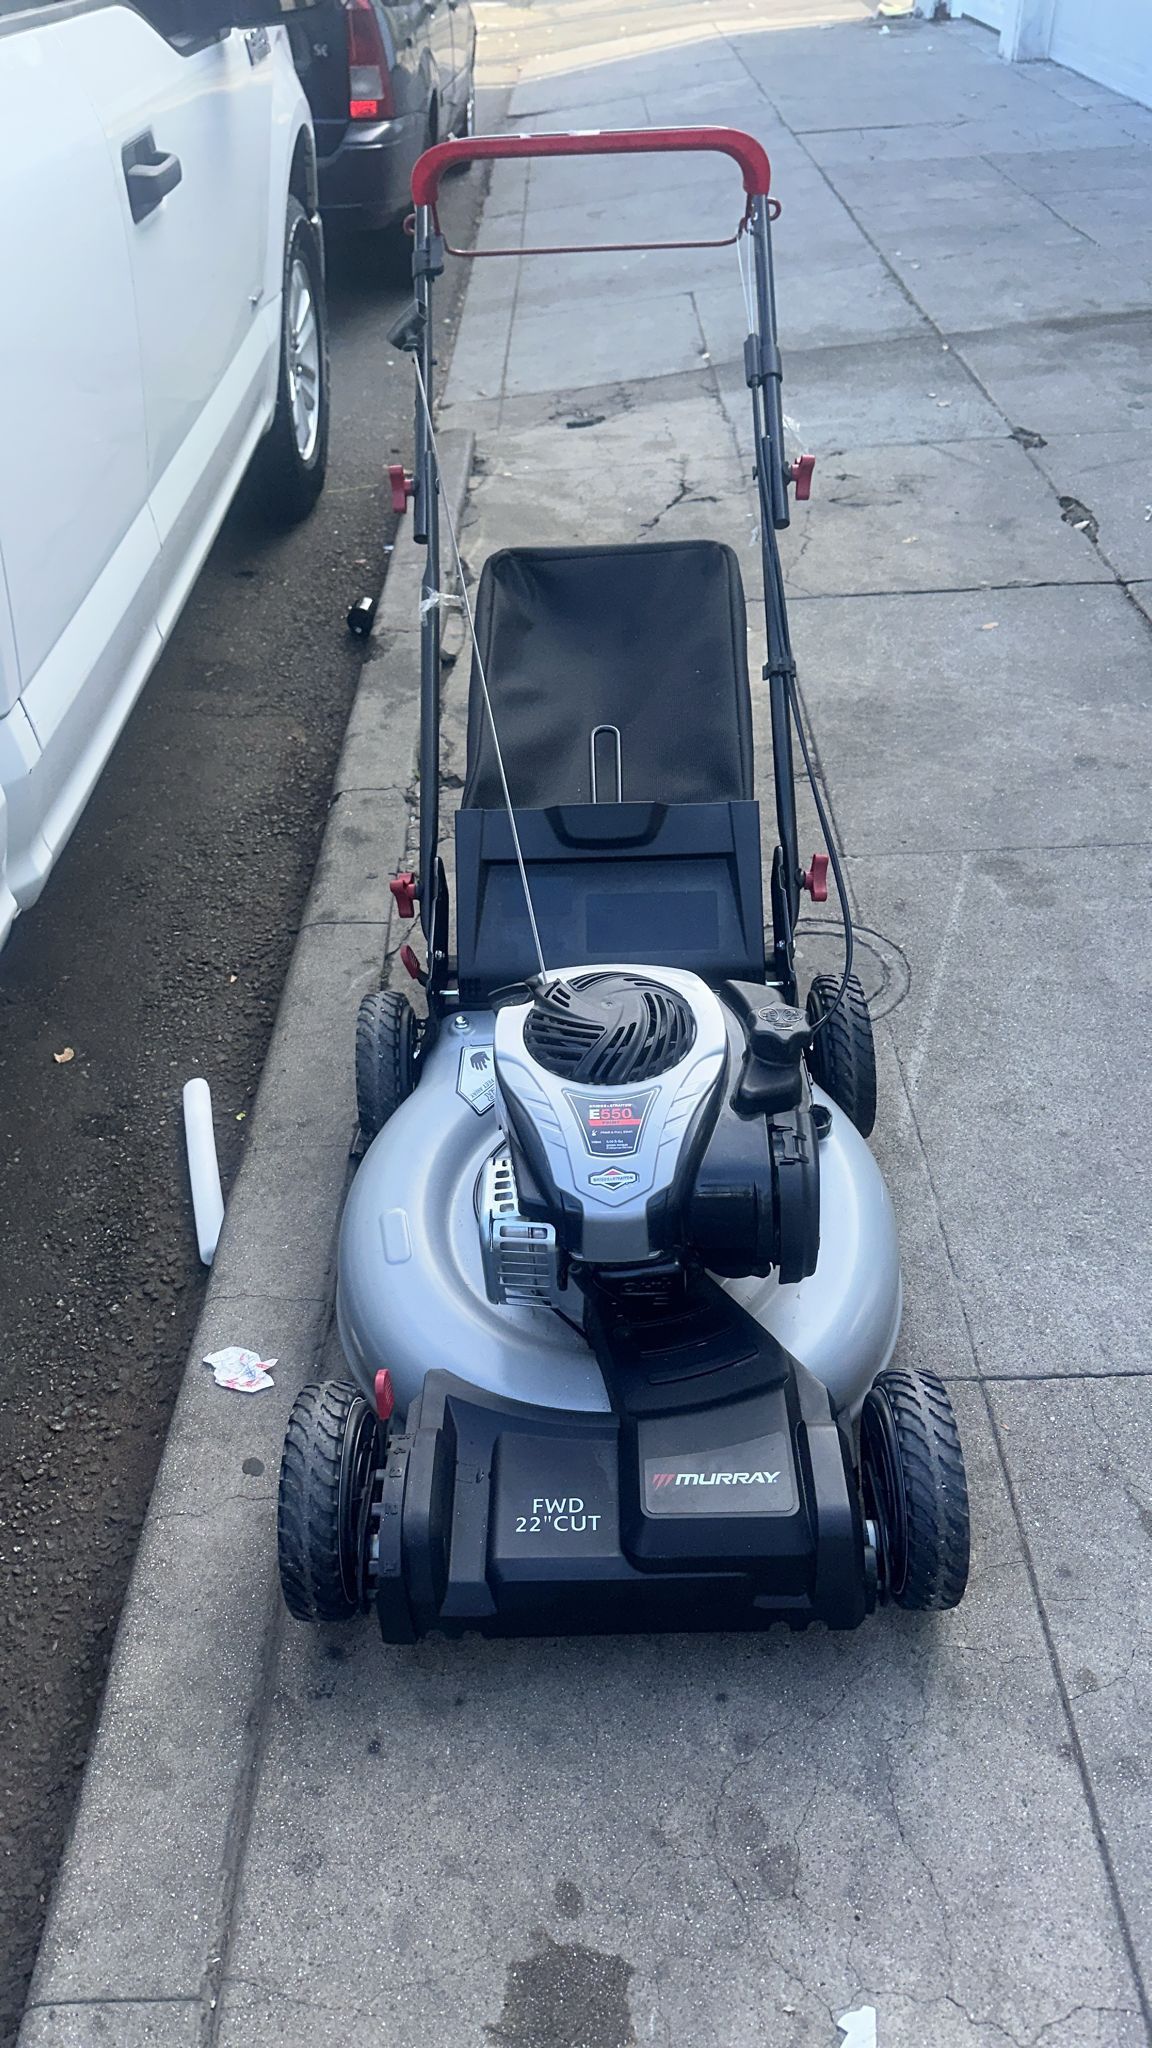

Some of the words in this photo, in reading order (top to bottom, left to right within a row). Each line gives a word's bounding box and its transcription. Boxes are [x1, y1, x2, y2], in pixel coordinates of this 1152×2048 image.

[589, 1108, 632, 1120] E550
[675, 1471, 781, 1486] MURRAY
[532, 1498, 584, 1514] FWD
